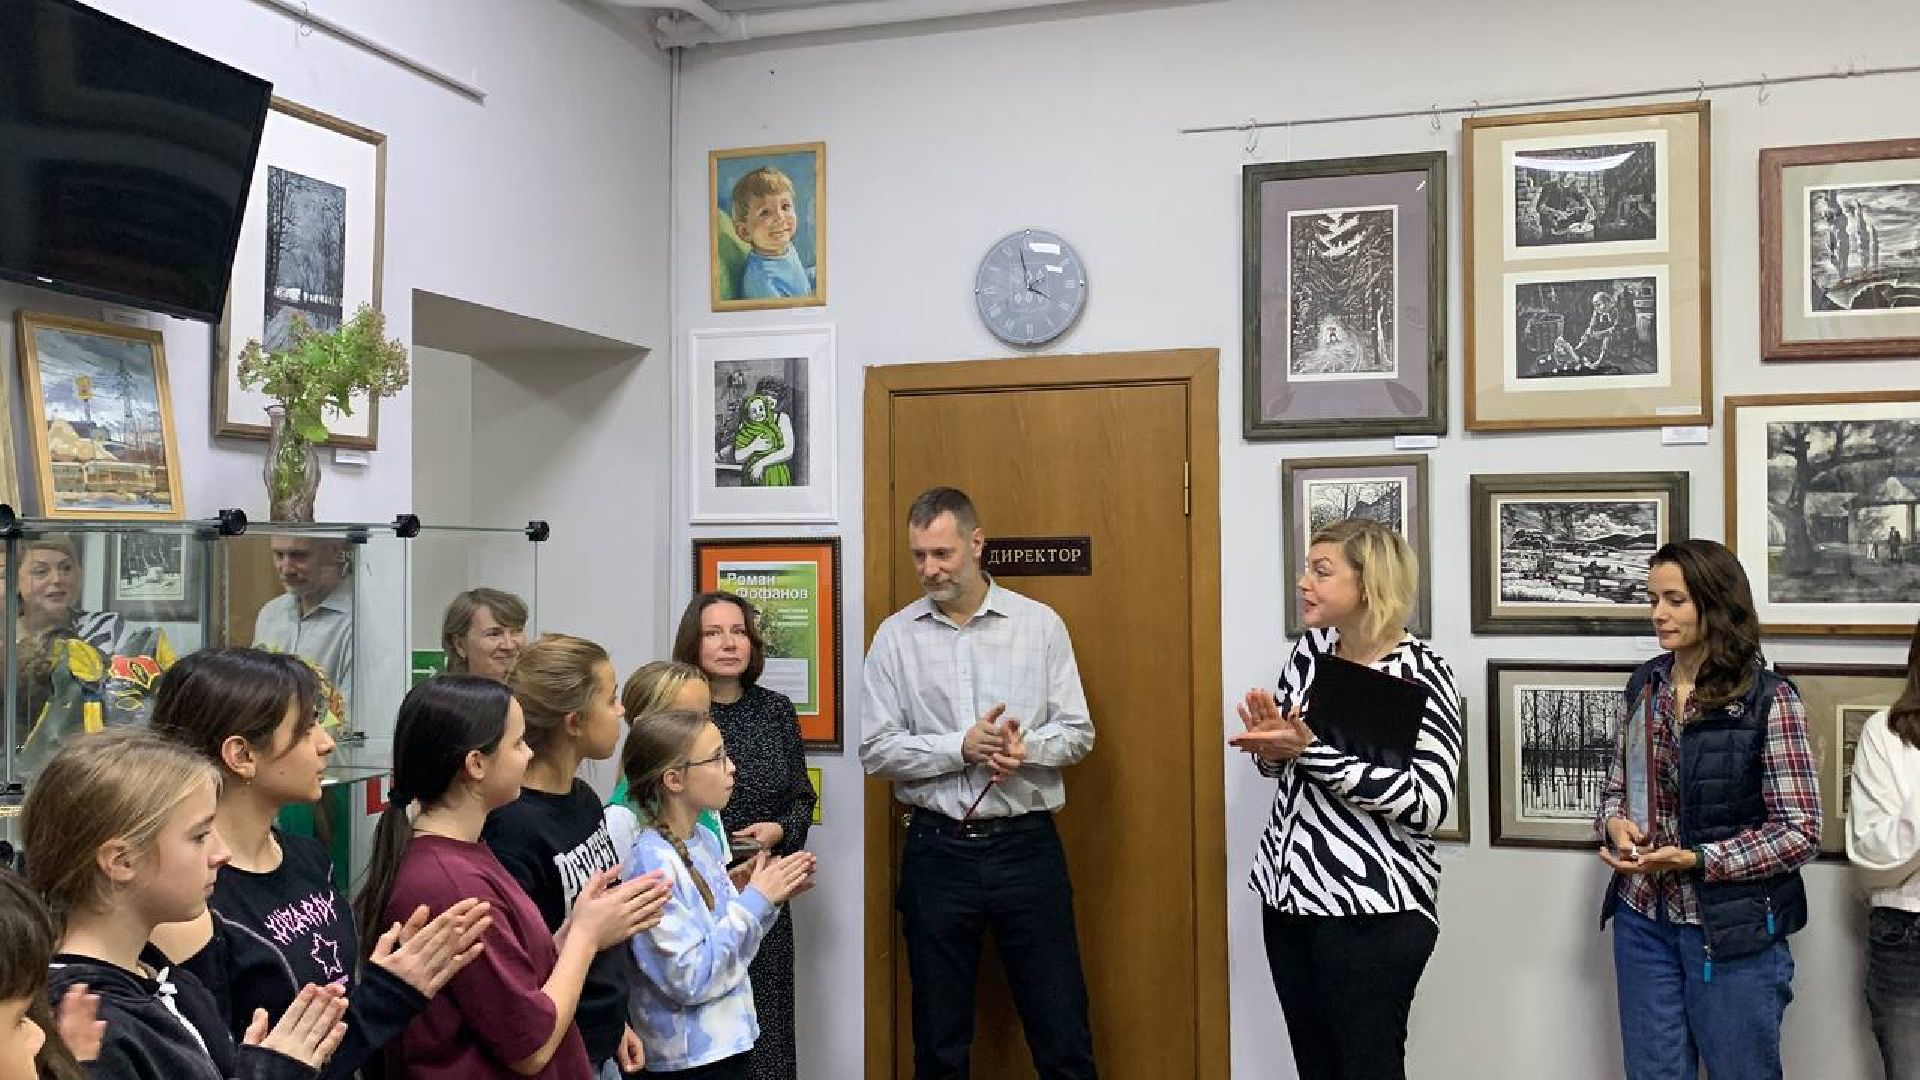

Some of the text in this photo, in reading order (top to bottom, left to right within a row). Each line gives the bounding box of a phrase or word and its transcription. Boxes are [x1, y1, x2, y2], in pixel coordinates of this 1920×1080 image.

[987, 548, 1082, 565] ДИРЕКТОР
[726, 571, 776, 586] Роман
[735, 588, 809, 602] Фофанов
